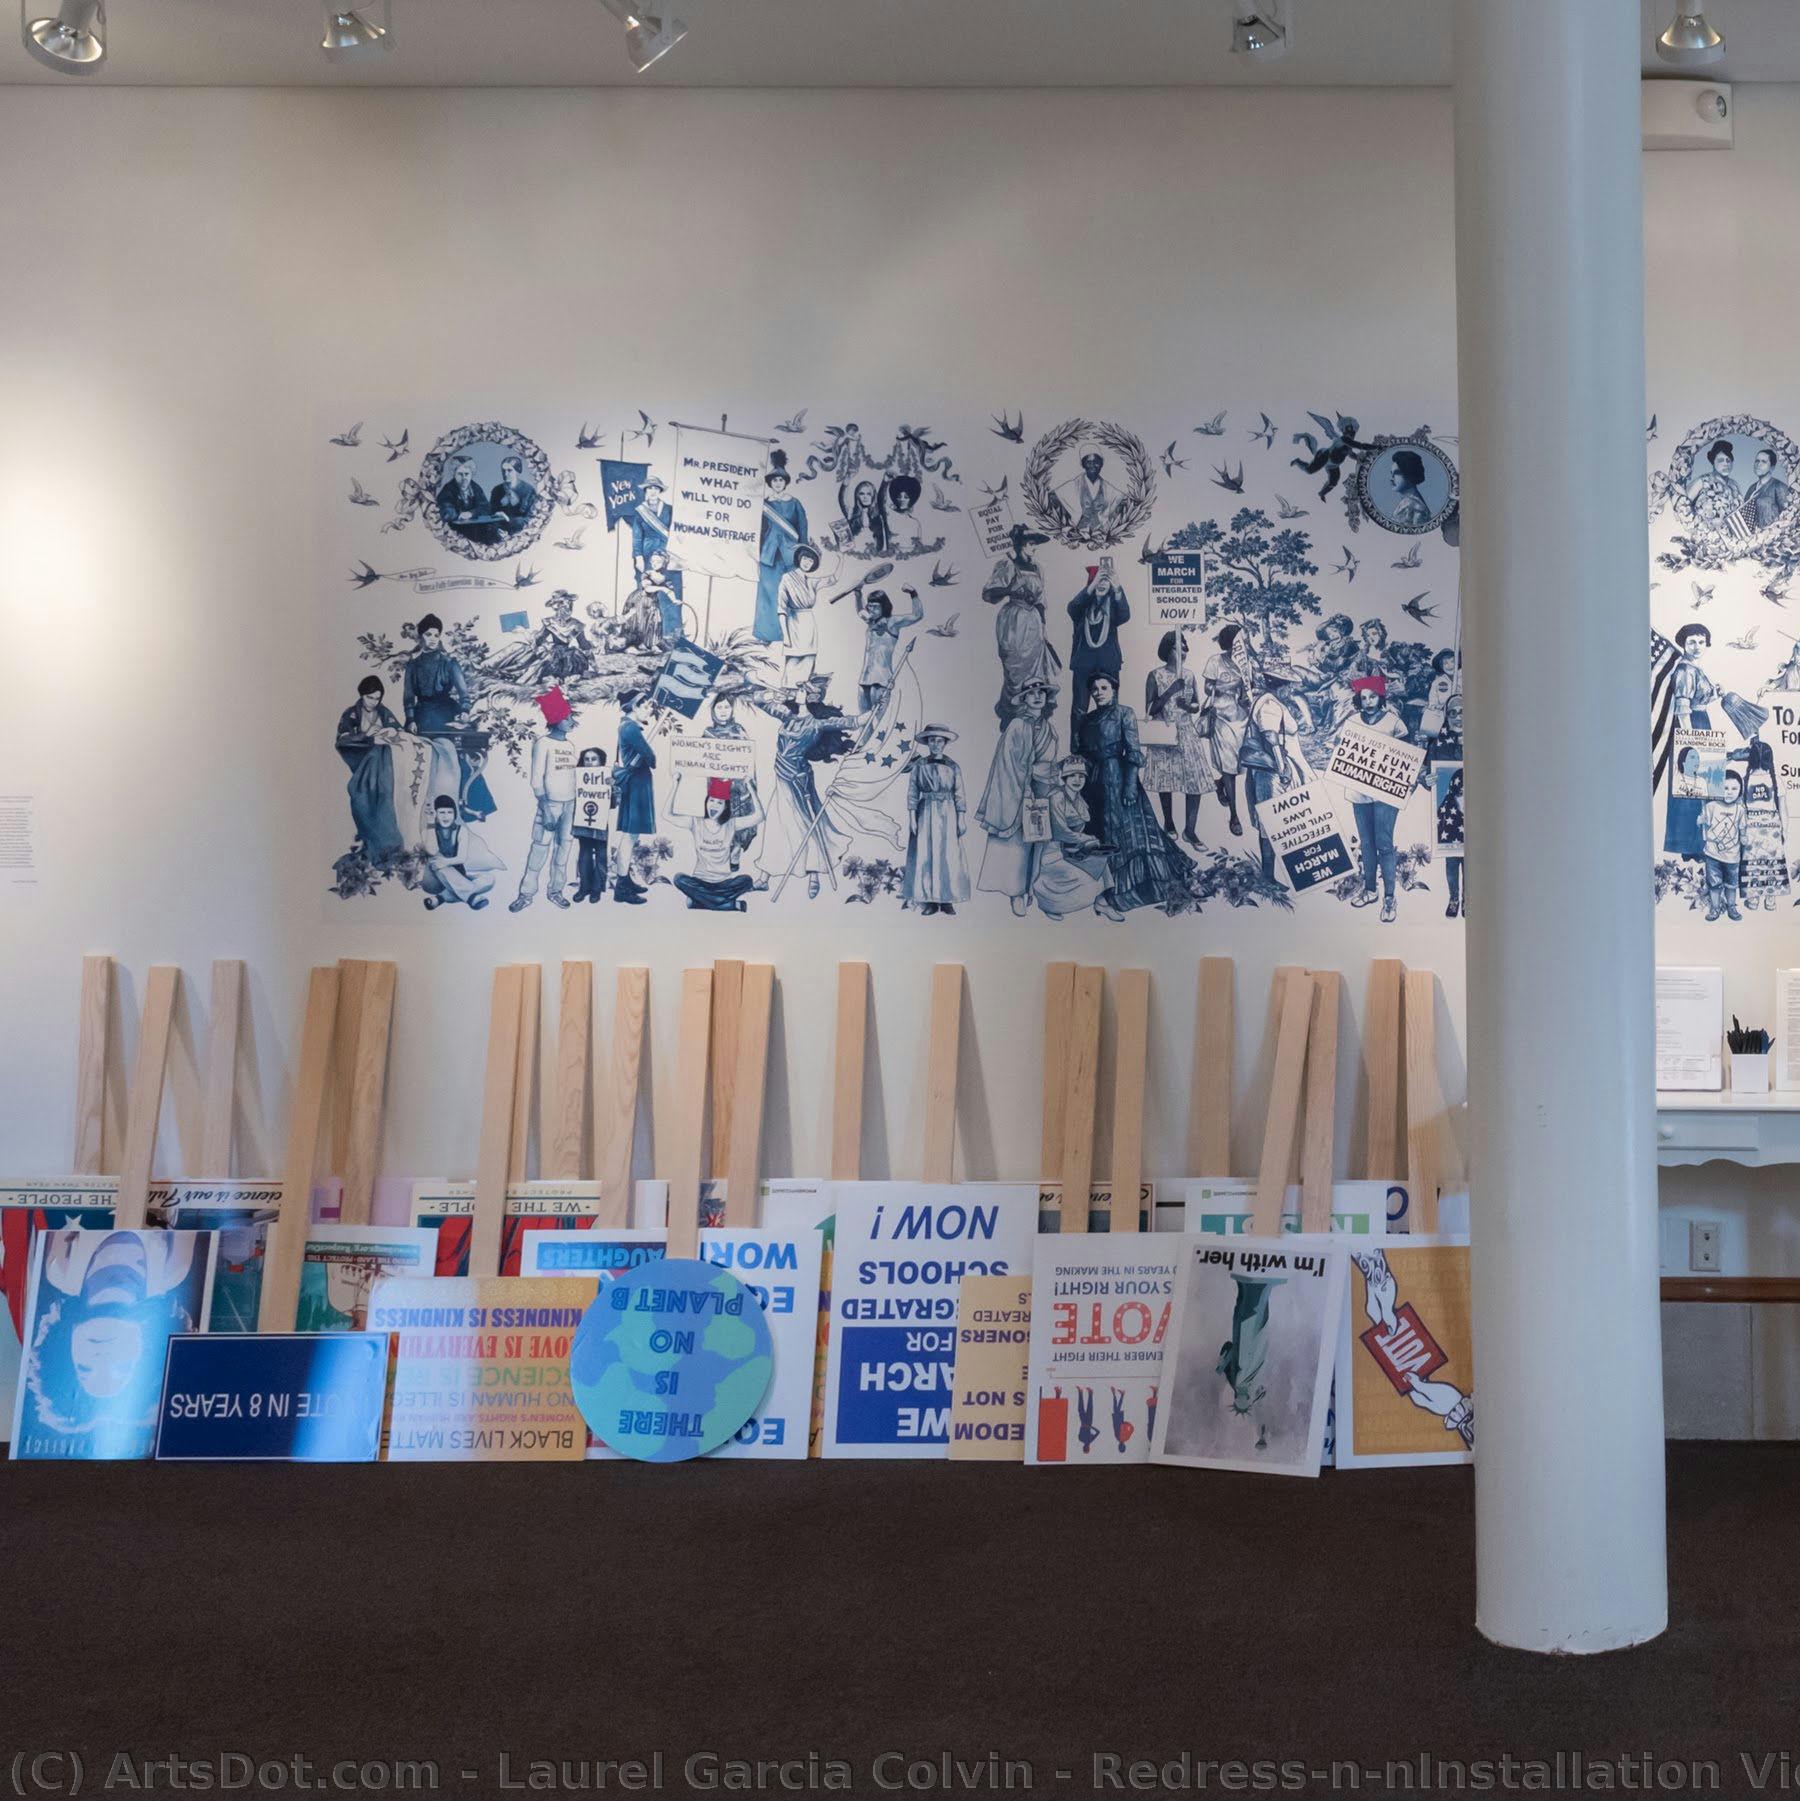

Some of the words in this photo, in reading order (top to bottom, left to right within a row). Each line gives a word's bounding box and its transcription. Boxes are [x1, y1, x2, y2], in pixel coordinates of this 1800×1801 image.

[703, 462, 758, 477] PRESIDENT
[700, 477, 739, 490] WHAT
[681, 491, 708, 503] WILL
[712, 495, 732, 506] YOU
[737, 499, 751, 509] DO
[706, 511, 729, 522] FOR
[674, 522, 710, 537] WOMAN
[712, 526, 756, 542] SUFFRAGE
[1168, 556, 1184, 564] WE
[1158, 568, 1195, 576] MARCH
[1773, 706, 1794, 726] TO
[1676, 729, 1726, 738] SOLIDARITY
[672, 740, 713, 750] WOMEN'S
[715, 743, 752, 753] RIGHTS
[1341, 738, 1376, 757] HAVE
[1345, 729, 1367, 743] GIRLS
[1369, 737, 1387, 750] JUST
[1389, 746, 1419, 763] WANNA
[675, 760, 706, 770] HUMAN
[702, 752, 721, 761] ARE
[1337, 748, 1412, 783] DAMENTAL
[583, 772, 604, 785] Girl
[1333, 762, 1372, 783] HUMAN
[1373, 776, 1408, 797] RIGHTS
[578, 788, 610, 800] Power!
[1272, 791, 1310, 814] NOW!
[1283, 808, 1312, 825] LAWS
[1309, 811, 1333, 827] CIVIL
[1271, 824, 1307, 842] RIGHTS
[1282, 824, 1331, 850] EFFECTIVE
[1304, 845, 1321, 856] FOR
[1295, 848, 1339, 873] MARCH
[1314, 866, 1333, 881] WE
[18, 1194, 81, 1205] PEOPLE
[511, 1200, 546, 1212] THE
[552, 1201, 582, 1212] WE
[1196, 1248, 1235, 1267] her.
[1239, 1253, 1287, 1274] with
[1055, 1267, 1098, 1275] MAKING
[1101, 1267, 1121, 1275] THE
[1136, 1266, 1170, 1275] YEARS
[1295, 1256, 1325, 1277] I'm
[1054, 1281, 1109, 1295] RIGHT!
[1114, 1281, 1159, 1294] YOUR
[611, 1289, 629, 1310] B
[636, 1288, 743, 1315] PLANET
[375, 1308, 465, 1327] KINDNESS
[469, 1309, 487, 1328] IS
[492, 1308, 582, 1328] KINDNESS
[505, 1336, 523, 1358] IS
[650, 1330, 694, 1353] NO
[906, 1332, 953, 1352] FOR
[1053, 1351, 1086, 1362] FIGHT
[1088, 1351, 1121, 1361] THEIR
[656, 1370, 678, 1395] IS
[171, 1393, 240, 1418] YEARS
[250, 1393, 259, 1418] 8
[265, 1393, 289, 1417] IN
[472, 1392, 540, 1406] HUMAN
[962, 1392, 1005, 1405] NOT
[619, 1410, 704, 1438] THERE
[897, 1408, 952, 1437] WE
[450, 1431, 504, 1448] LIVES
[511, 1431, 573, 1448] BLACK
